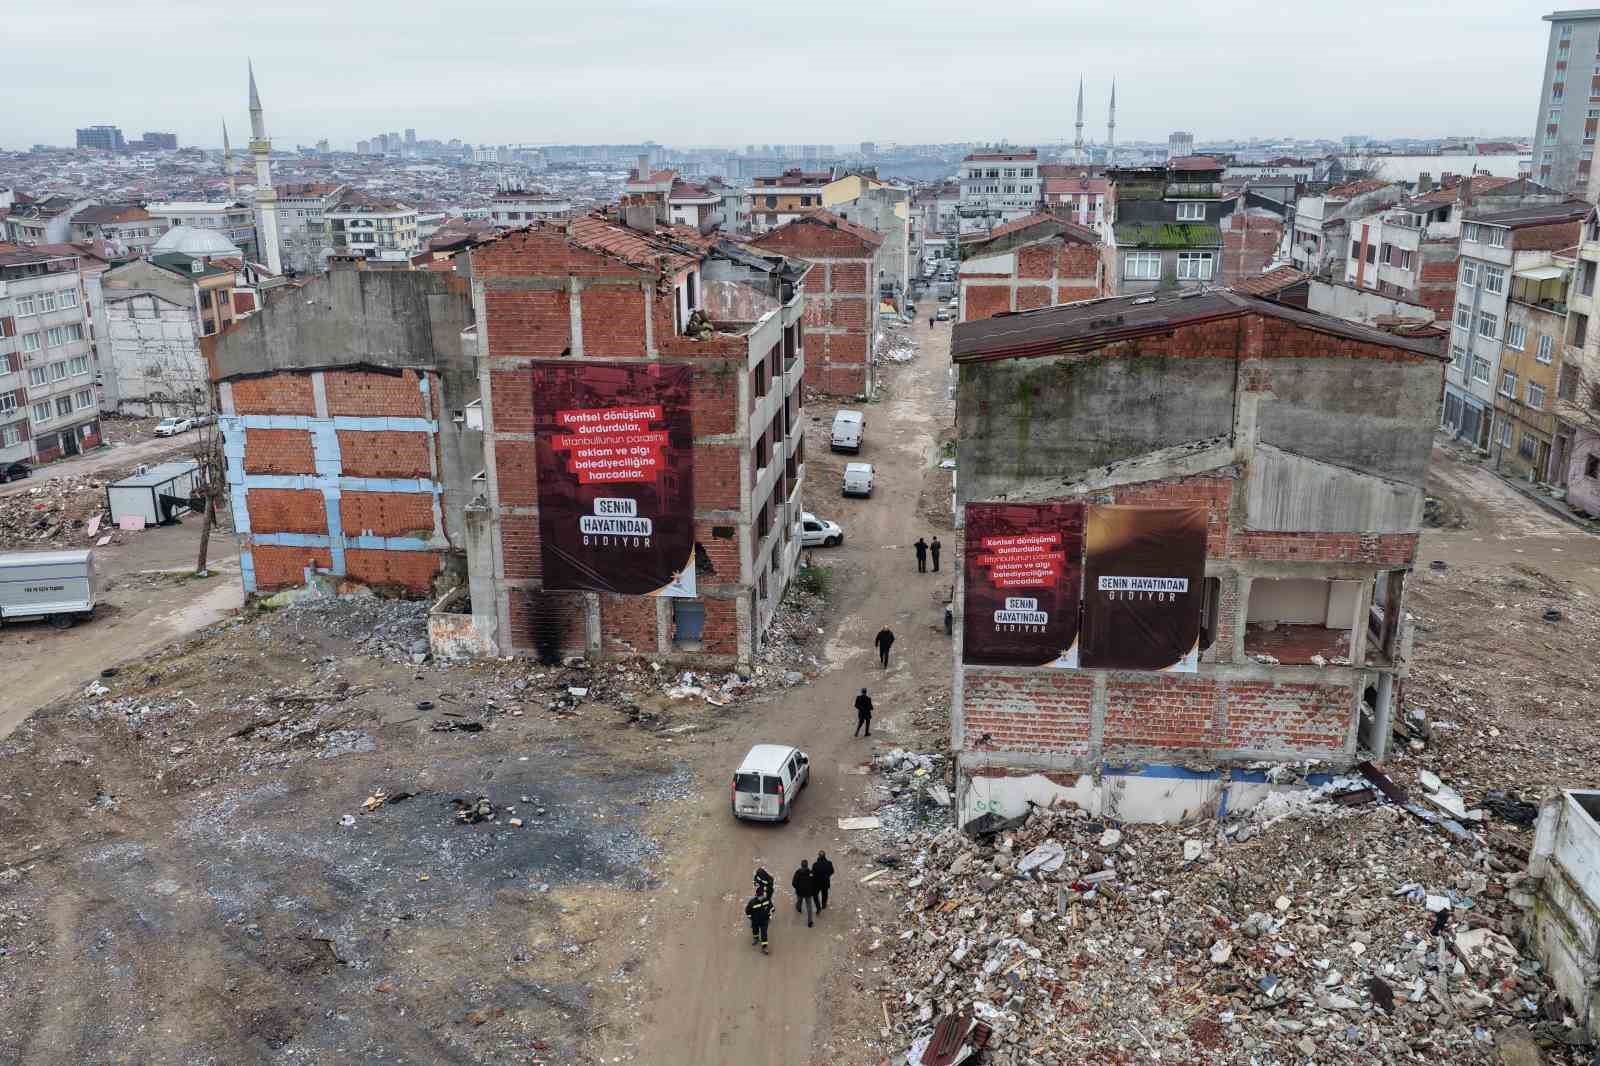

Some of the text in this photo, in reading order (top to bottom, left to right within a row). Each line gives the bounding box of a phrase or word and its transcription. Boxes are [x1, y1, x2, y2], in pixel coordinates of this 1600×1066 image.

[563, 409, 656, 423] Kentsel dönüşümü
[577, 448, 613, 457] reklam
[631, 446, 650, 456] algı
[589, 470, 644, 480] harcadılar.
[584, 519, 648, 534] HAYATINDAN
[1131, 579, 1185, 591] HAYATINDAN
[997, 612, 1045, 623] HAYATINDAN
